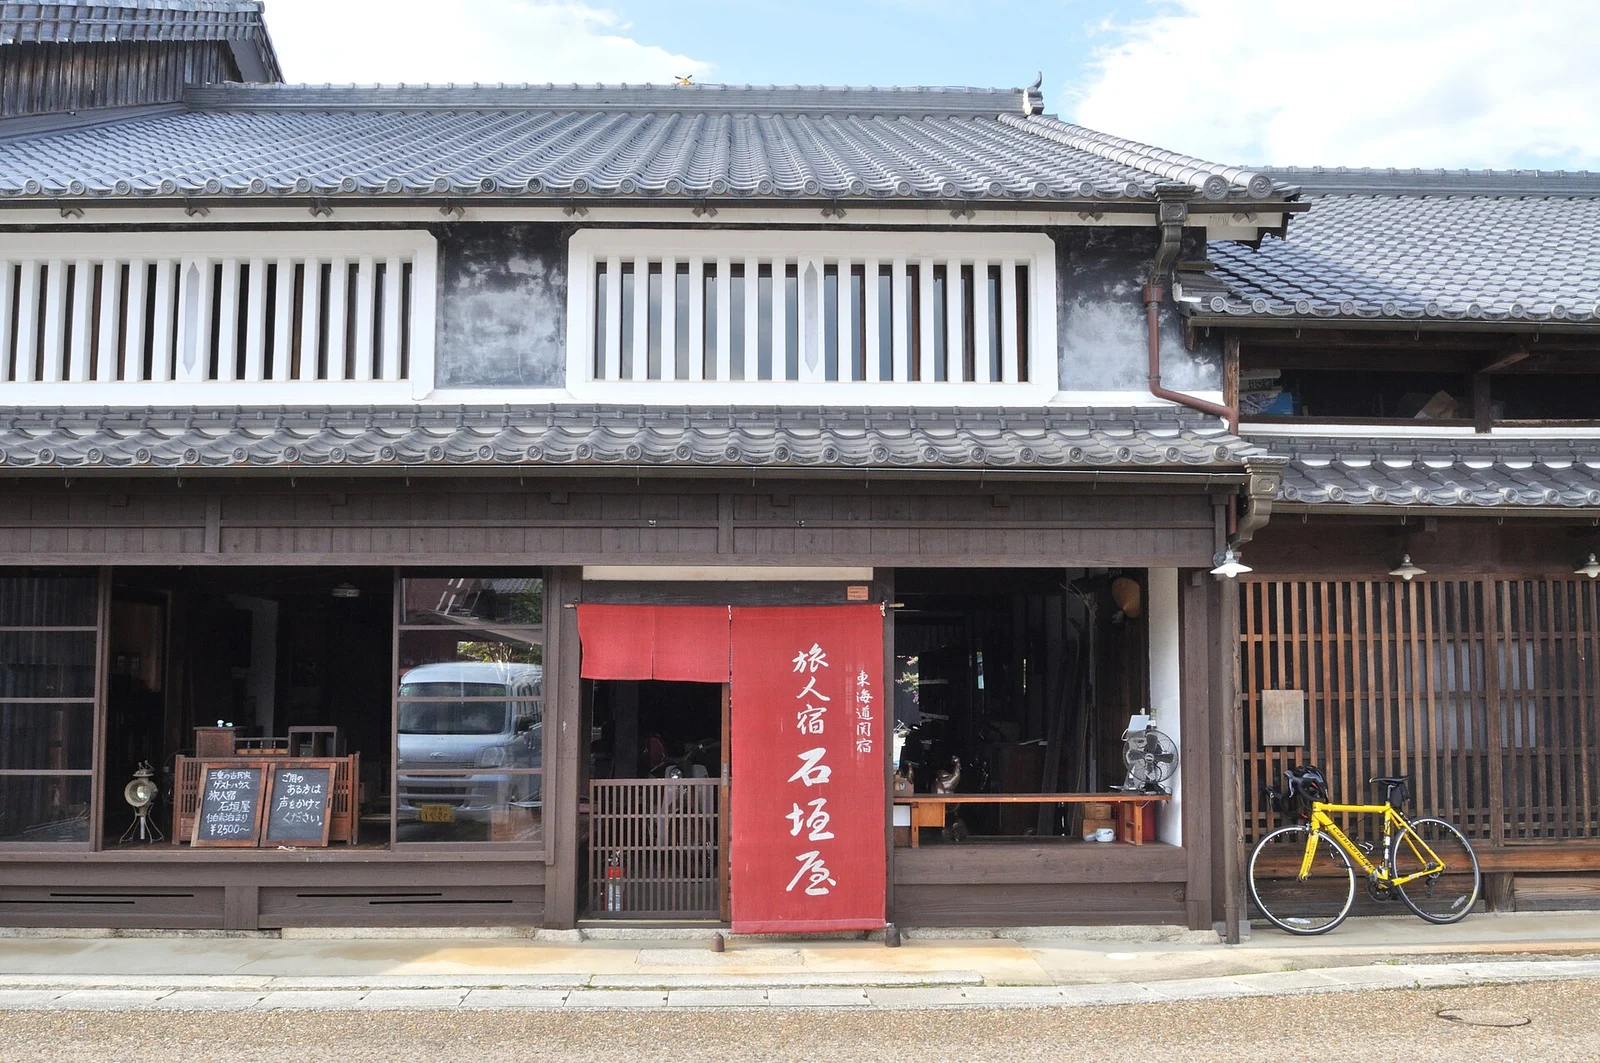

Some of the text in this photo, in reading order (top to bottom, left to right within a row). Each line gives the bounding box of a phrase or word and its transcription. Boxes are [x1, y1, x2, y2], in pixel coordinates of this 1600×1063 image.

[856, 669, 873, 753] 東海道関宿
[210, 770, 252, 780] 三重の古民家
[281, 772, 304, 783] ご用の
[213, 780, 251, 790] ゲストハウス
[287, 784, 322, 796] ある方は
[207, 790, 237, 801] 旅人宿
[217, 801, 251, 813] 石垣屋
[276, 796, 322, 812] 声をかけて
